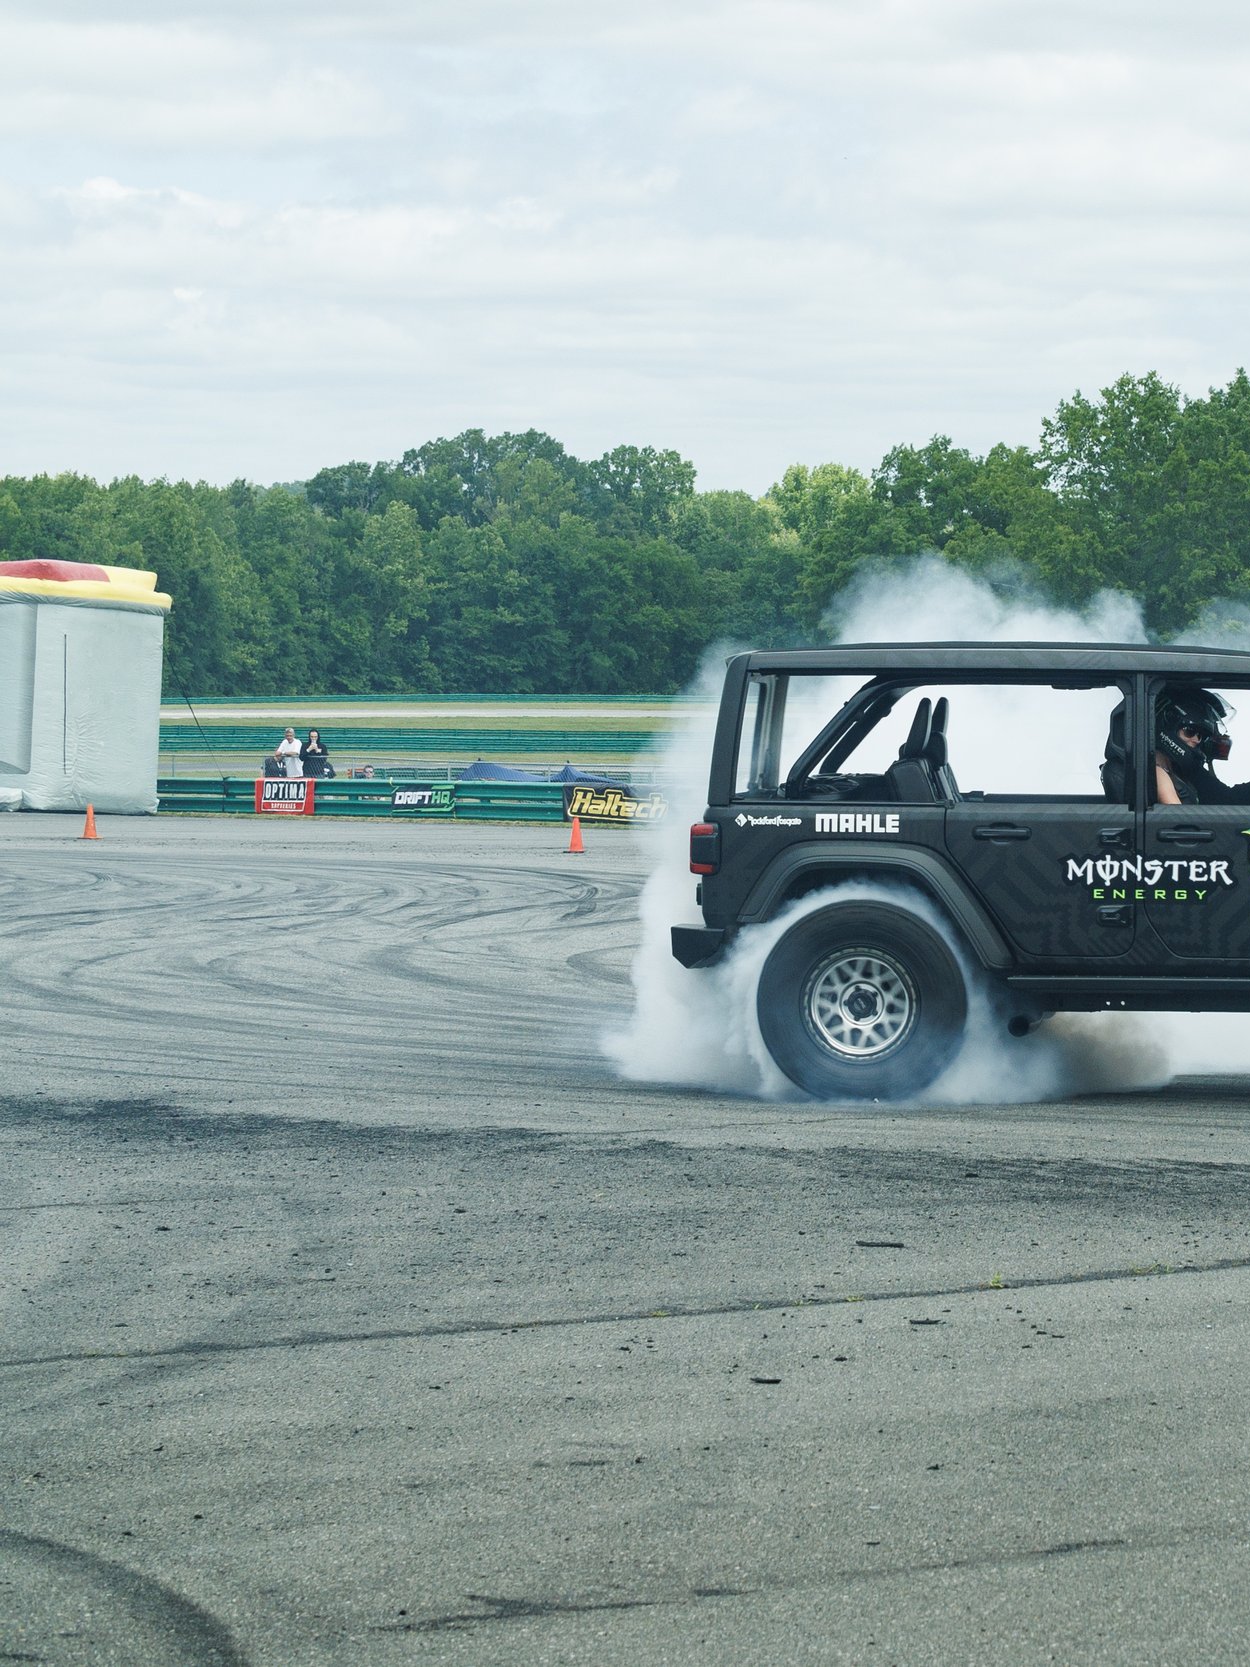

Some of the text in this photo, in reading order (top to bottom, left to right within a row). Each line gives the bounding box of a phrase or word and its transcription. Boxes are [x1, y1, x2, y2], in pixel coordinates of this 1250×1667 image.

[265, 783, 304, 799] OPTIMA
[570, 789, 668, 819] Haltech
[815, 813, 900, 833] MAHLE
[1066, 855, 1234, 886] MONSTER
[1093, 888, 1208, 901] ENERGY
